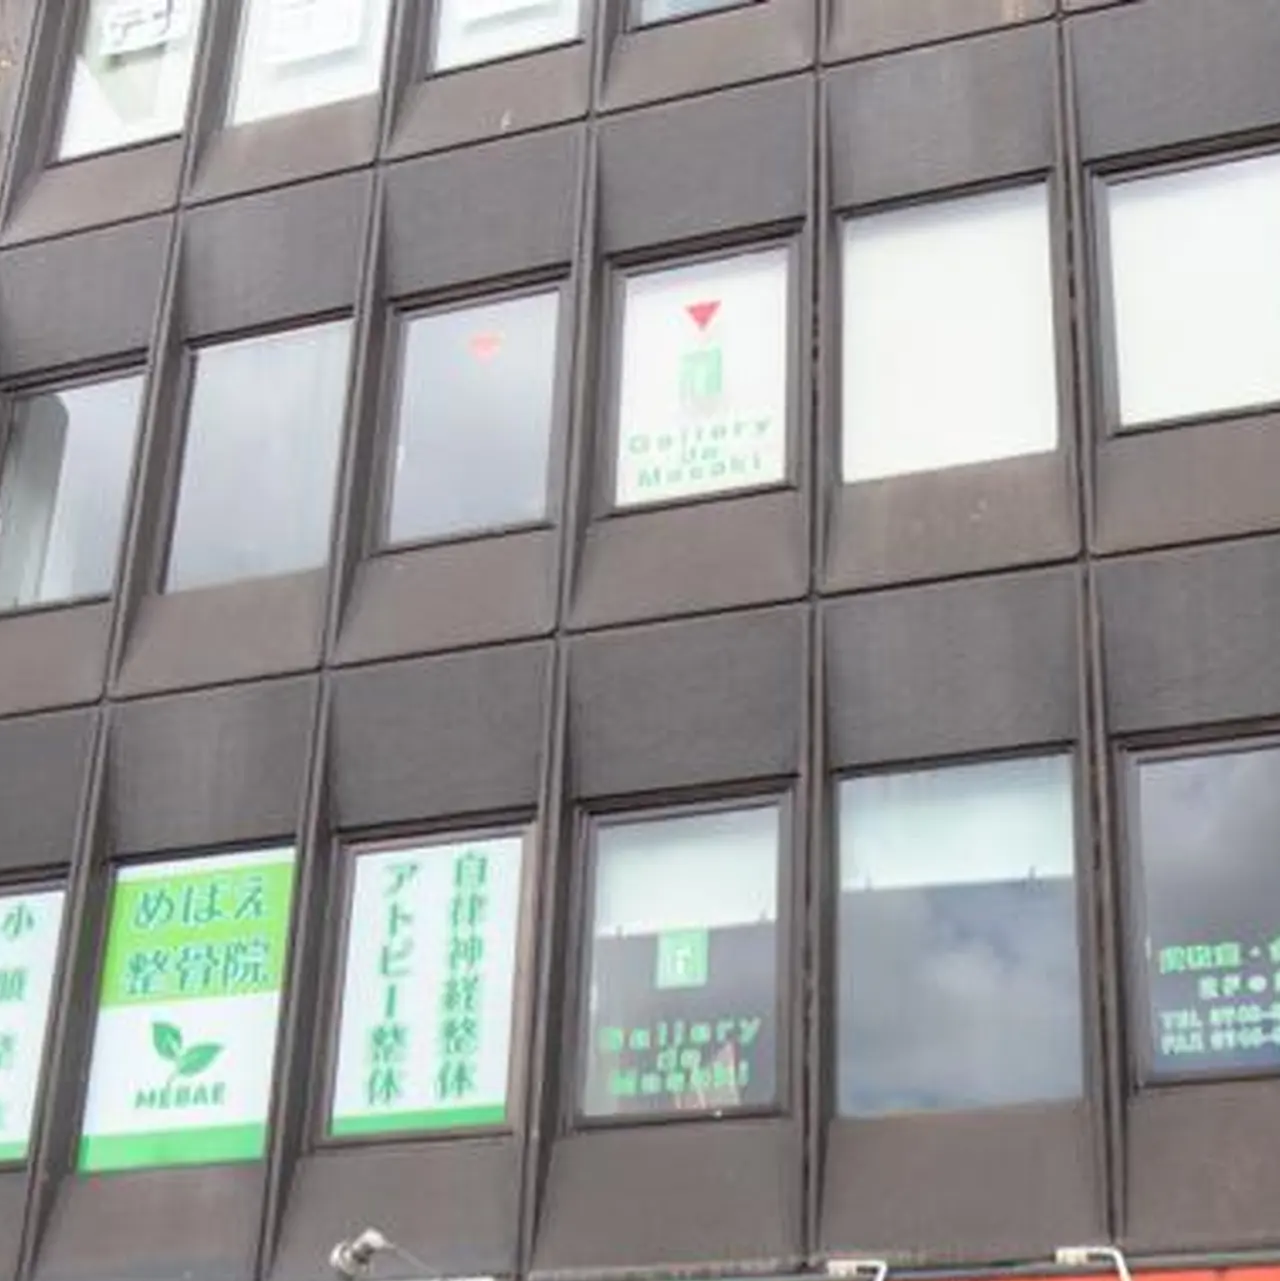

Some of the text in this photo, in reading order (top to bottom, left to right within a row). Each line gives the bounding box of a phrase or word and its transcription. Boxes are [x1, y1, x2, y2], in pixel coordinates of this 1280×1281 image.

[127, 936, 270, 995] 整骨院
[365, 861, 421, 1107] アトピー整体
[437, 850, 491, 1098] 自律神経整体
[134, 1081, 227, 1111] MEBAE
